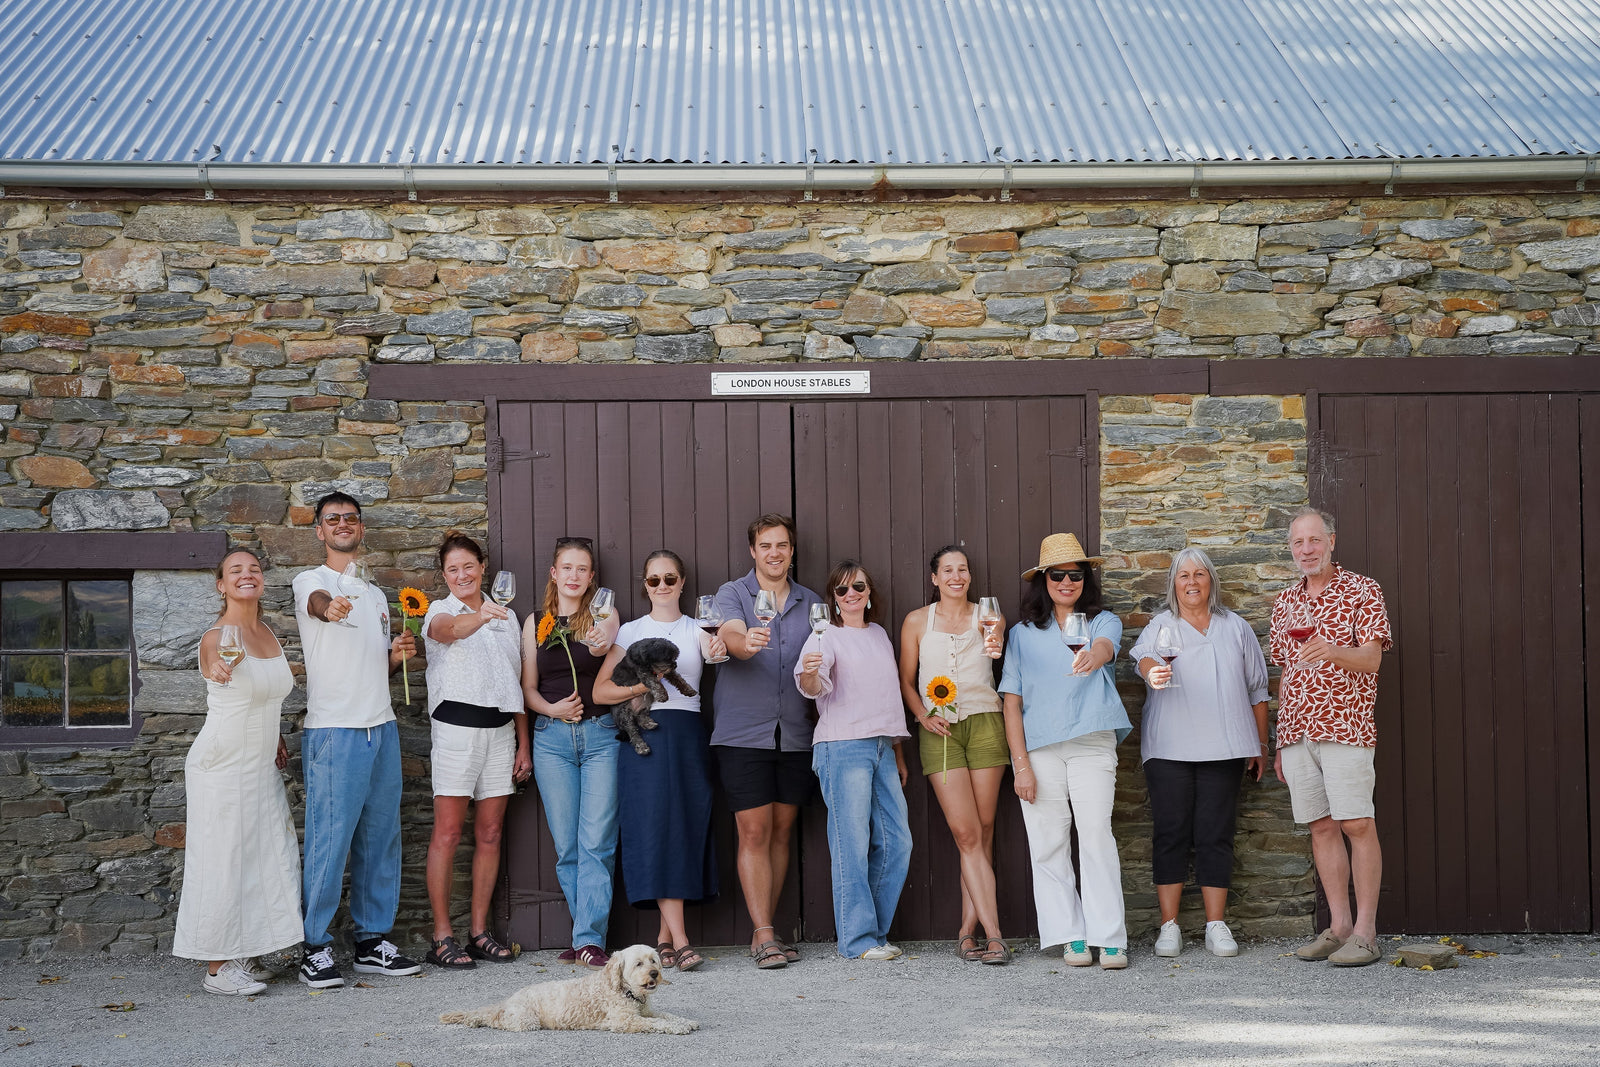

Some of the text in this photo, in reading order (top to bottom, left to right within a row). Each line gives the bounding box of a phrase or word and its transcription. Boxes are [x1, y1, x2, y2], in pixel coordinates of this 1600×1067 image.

[730, 378, 851, 388] LONDON HOUSE STABLES
